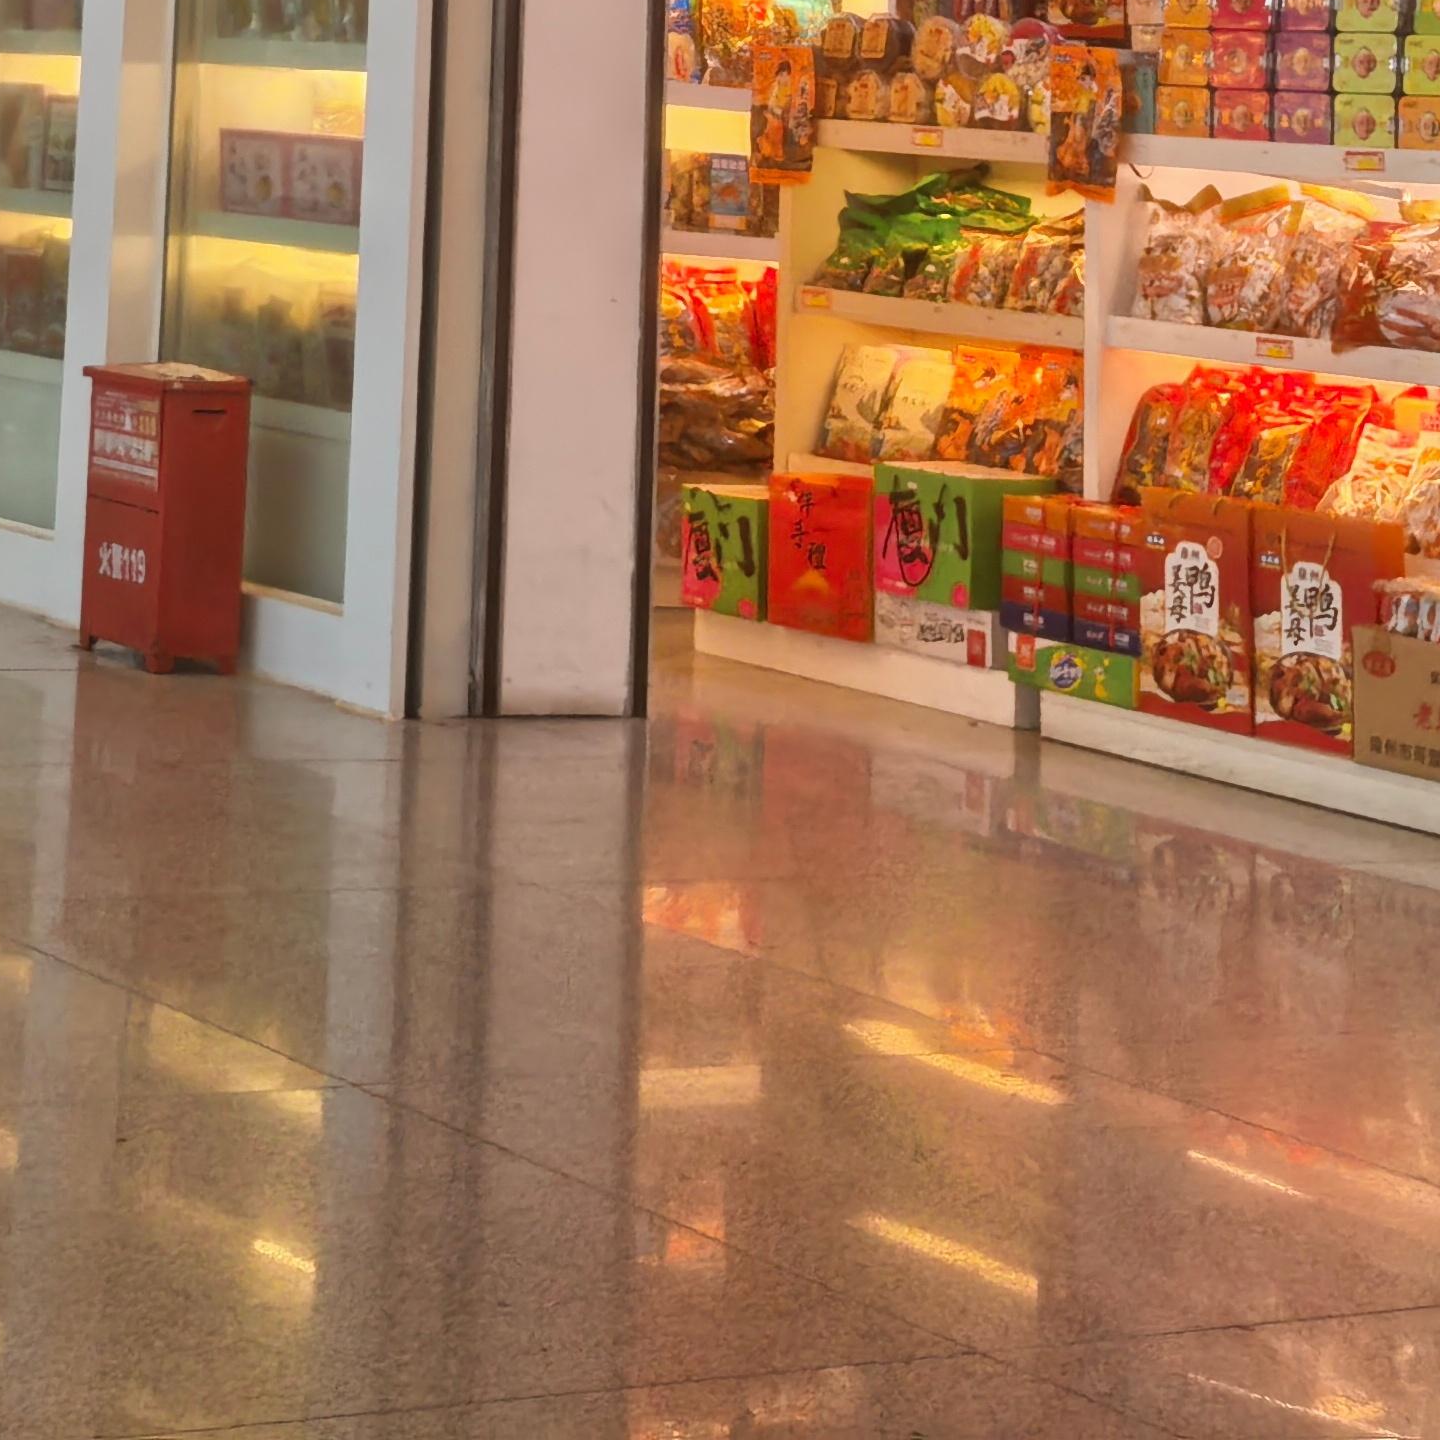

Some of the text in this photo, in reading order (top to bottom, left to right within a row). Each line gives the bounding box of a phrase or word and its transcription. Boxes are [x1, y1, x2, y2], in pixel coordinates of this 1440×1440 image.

[1167, 563, 1215, 623] 姜母鸭
[1284, 583, 1339, 646] 姜母鸭
